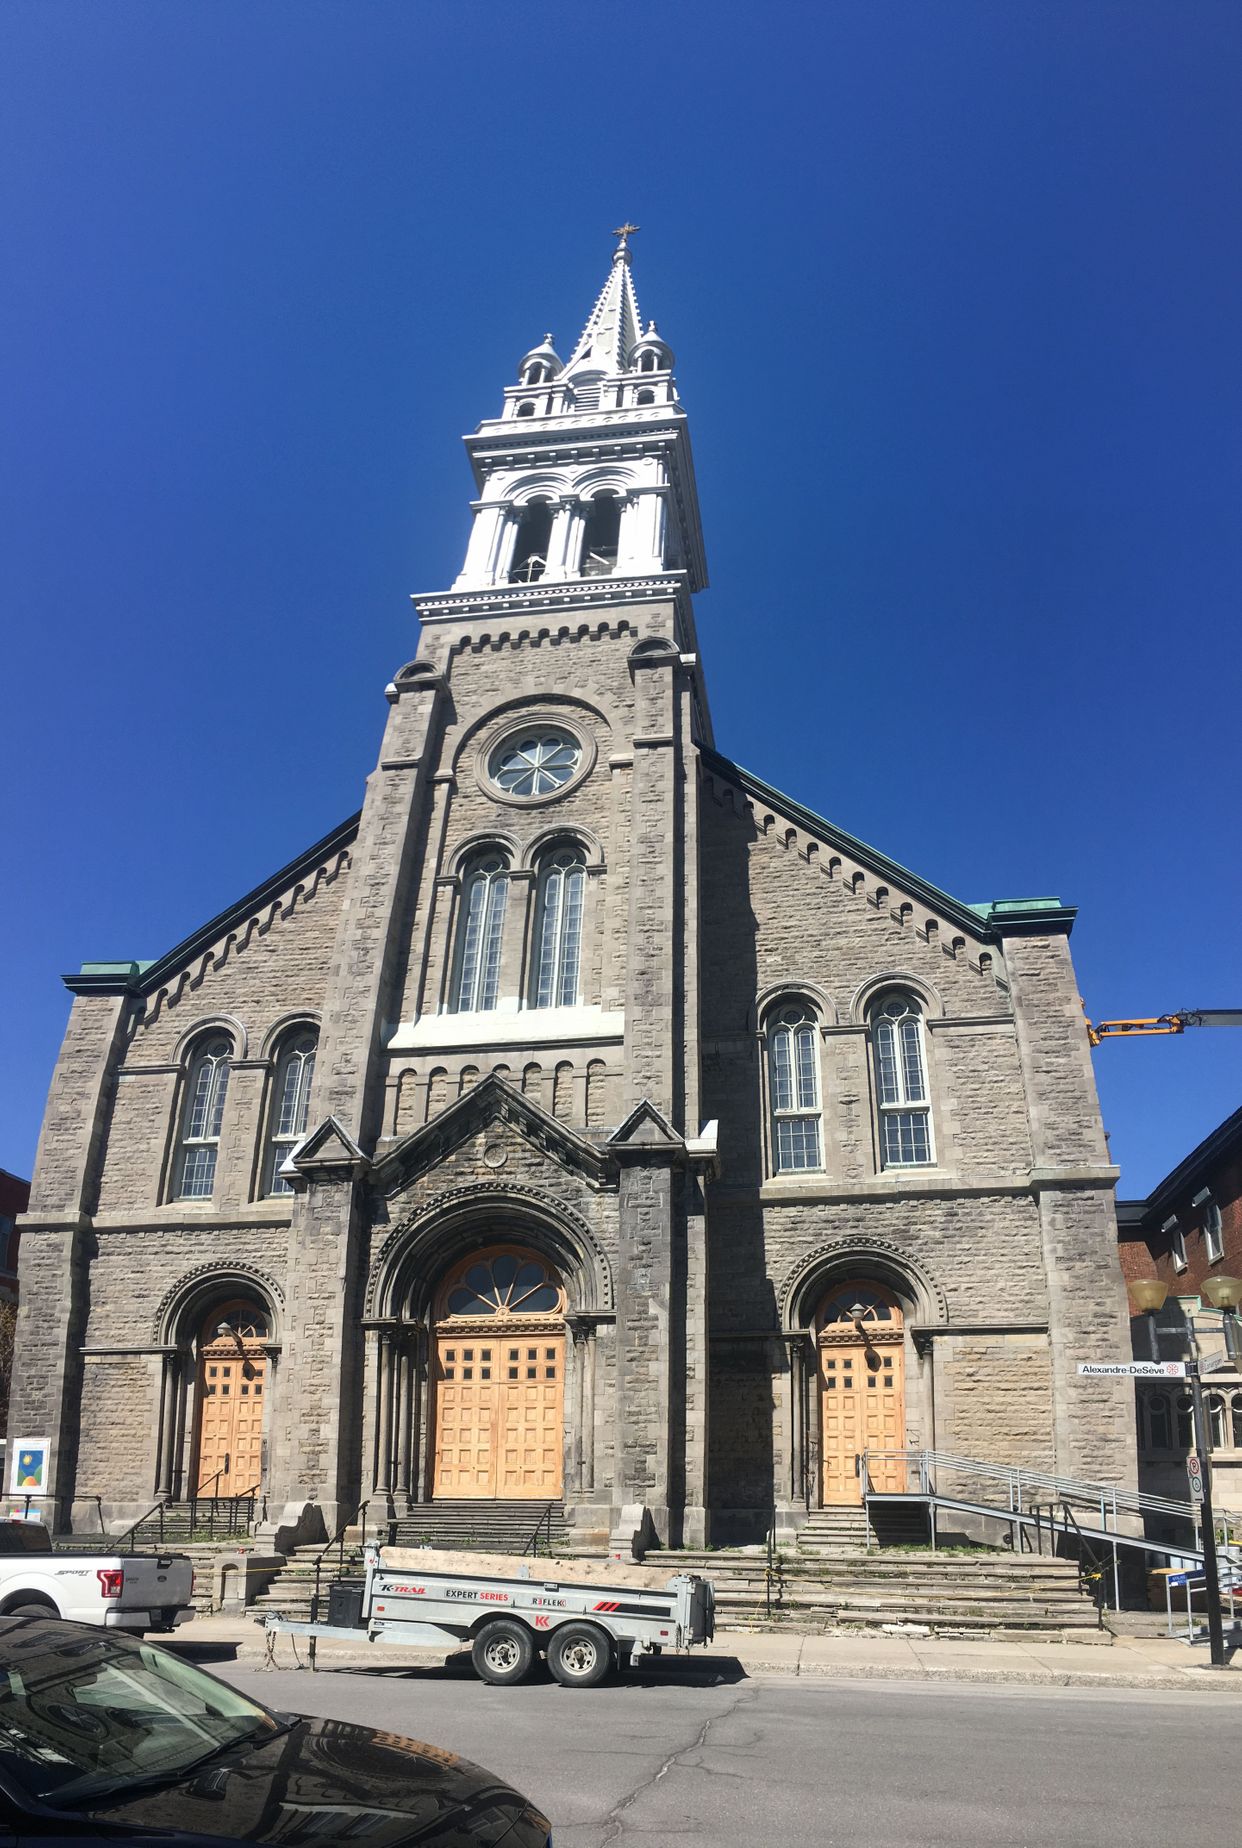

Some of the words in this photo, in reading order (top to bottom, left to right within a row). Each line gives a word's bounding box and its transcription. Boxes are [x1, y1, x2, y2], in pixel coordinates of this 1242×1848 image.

[1082, 1365, 1165, 1375] Alexandre-DeSève
[446, 1590, 478, 1600] EXPERT
[480, 1592, 509, 1601] SERIES
